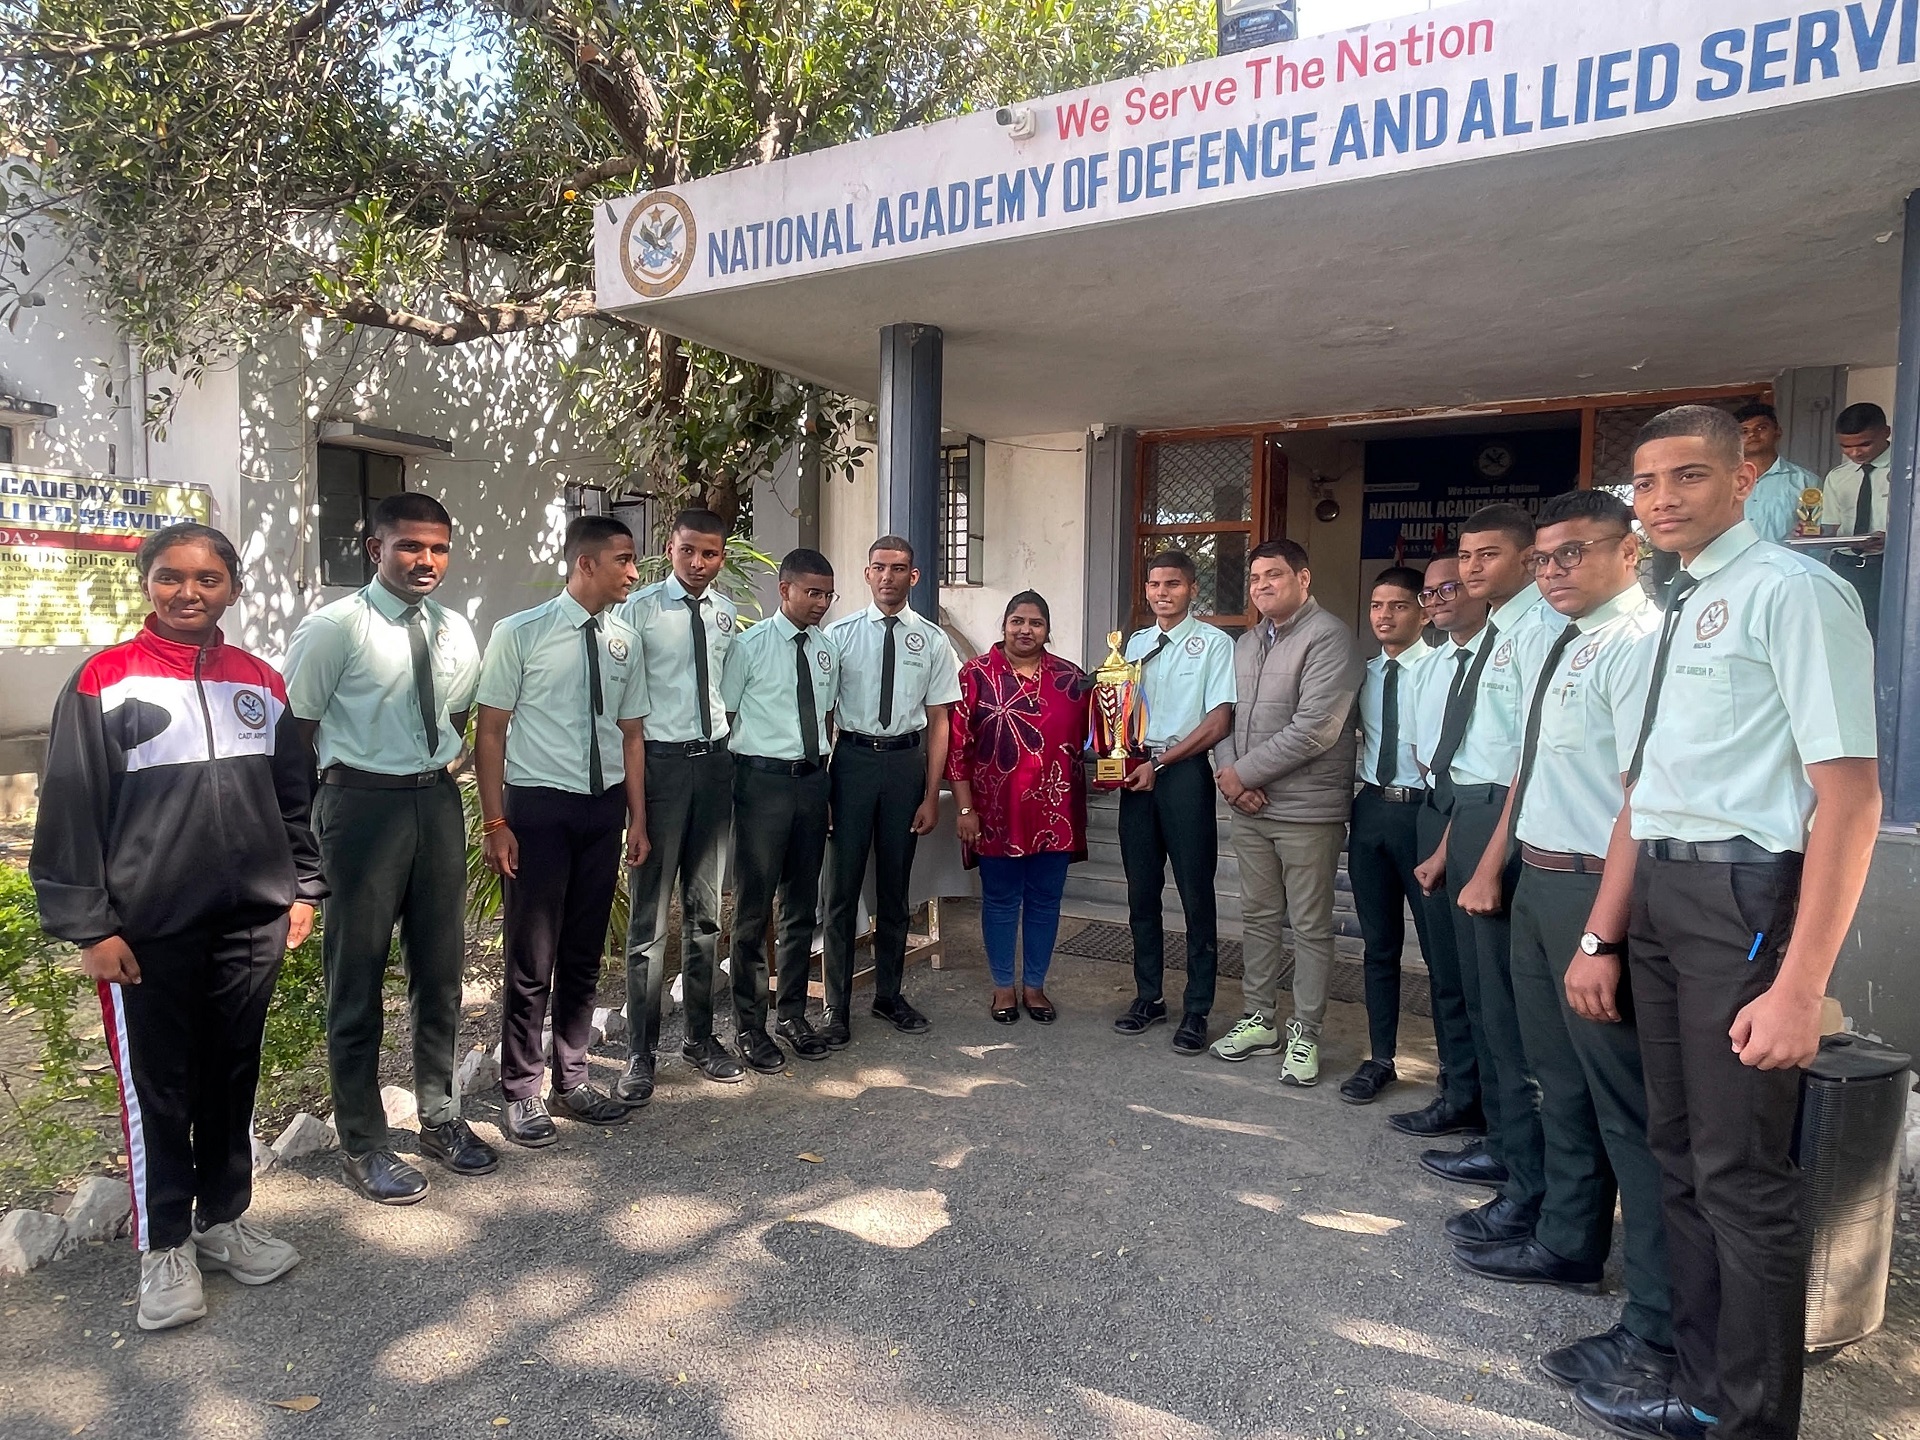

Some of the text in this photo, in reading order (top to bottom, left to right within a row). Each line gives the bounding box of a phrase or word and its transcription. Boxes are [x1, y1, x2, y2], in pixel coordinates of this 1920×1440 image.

[1056, 98, 1110, 141] We
[1125, 76, 1237, 126] Serve
[1245, 55, 1325, 98] The
[1336, 19, 1494, 82] Nation
[708, 199, 862, 279] NATIONAL
[873, 161, 1054, 248] ACADEMY
[1065, 154, 1108, 213] OF
[1118, 112, 1317, 204] DEFENCE
[1328, 86, 1448, 166] AND
[1458, 41, 1680, 144] ALLIED
[123, 488, 153, 506] OF
[1369, 501, 1433, 519] NATIONAL
[1436, 497, 1502, 518] ACADE
[39, 551, 117, 568] Discipline
